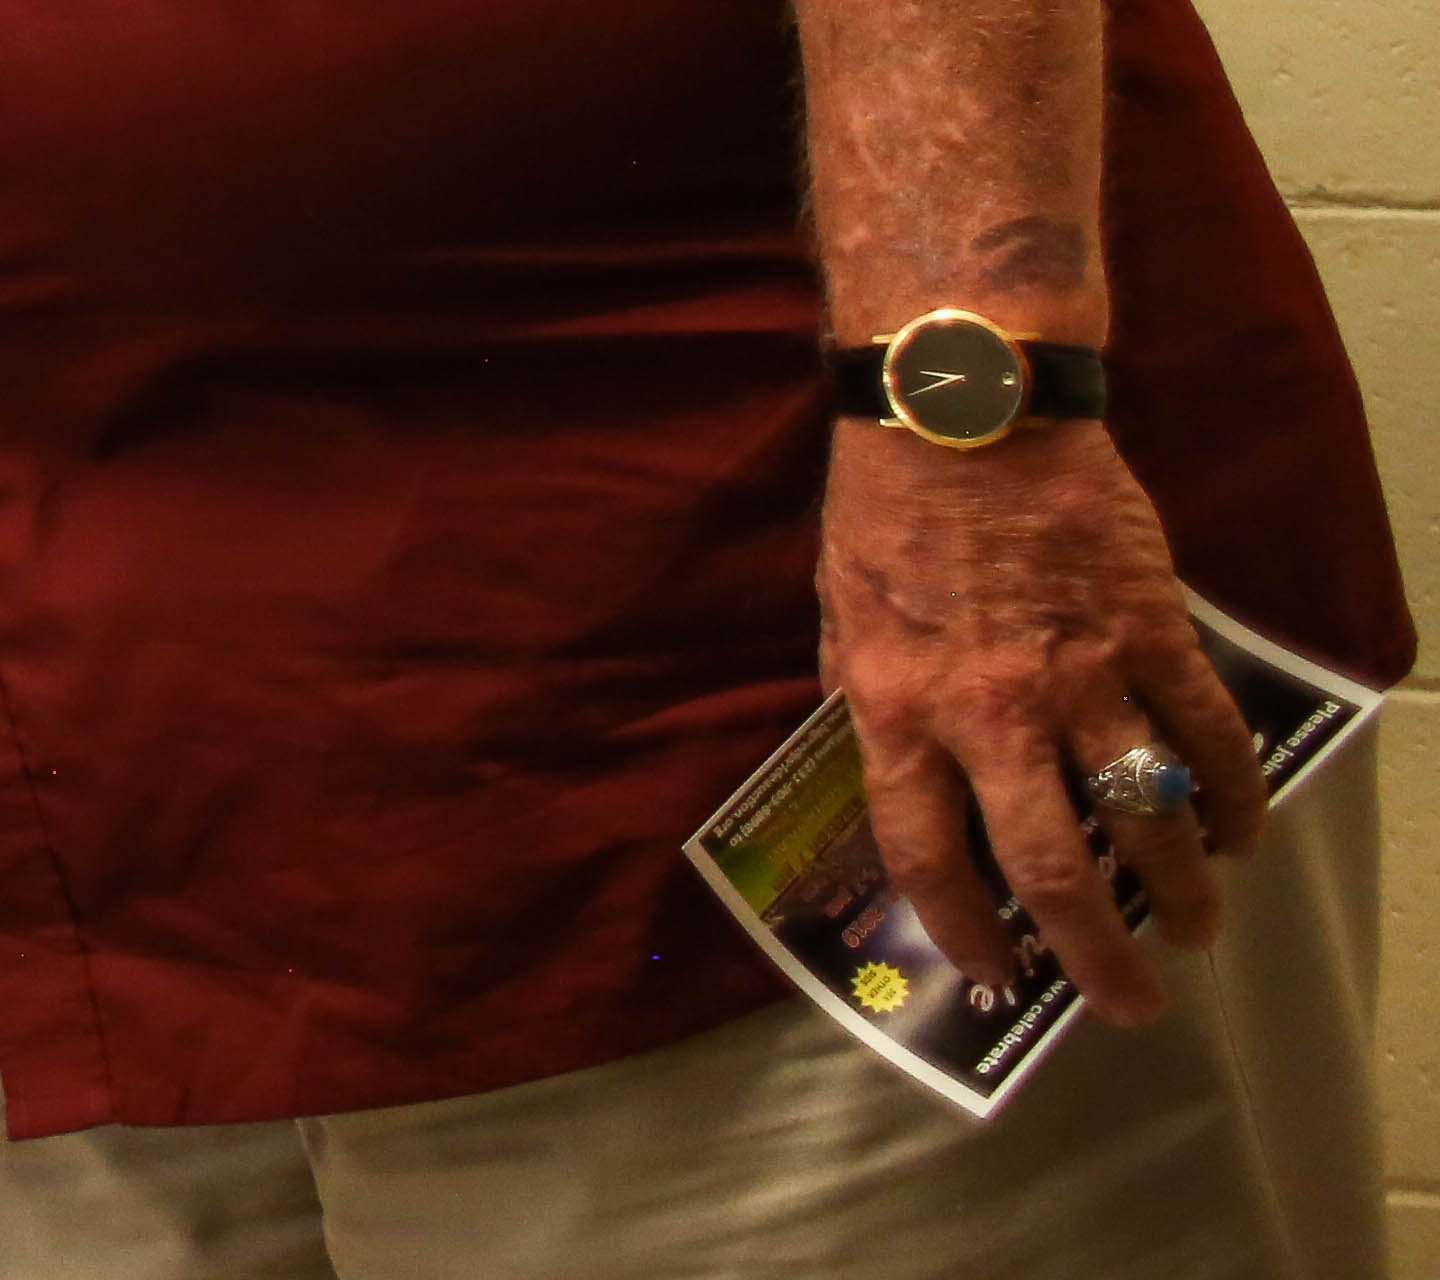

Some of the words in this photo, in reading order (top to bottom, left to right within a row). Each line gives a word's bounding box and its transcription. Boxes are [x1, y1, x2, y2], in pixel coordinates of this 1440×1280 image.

[1285, 700, 1341, 747] Please
[1040, 979, 1068, 1003] we
[976, 1004, 1042, 1074] celebrate
